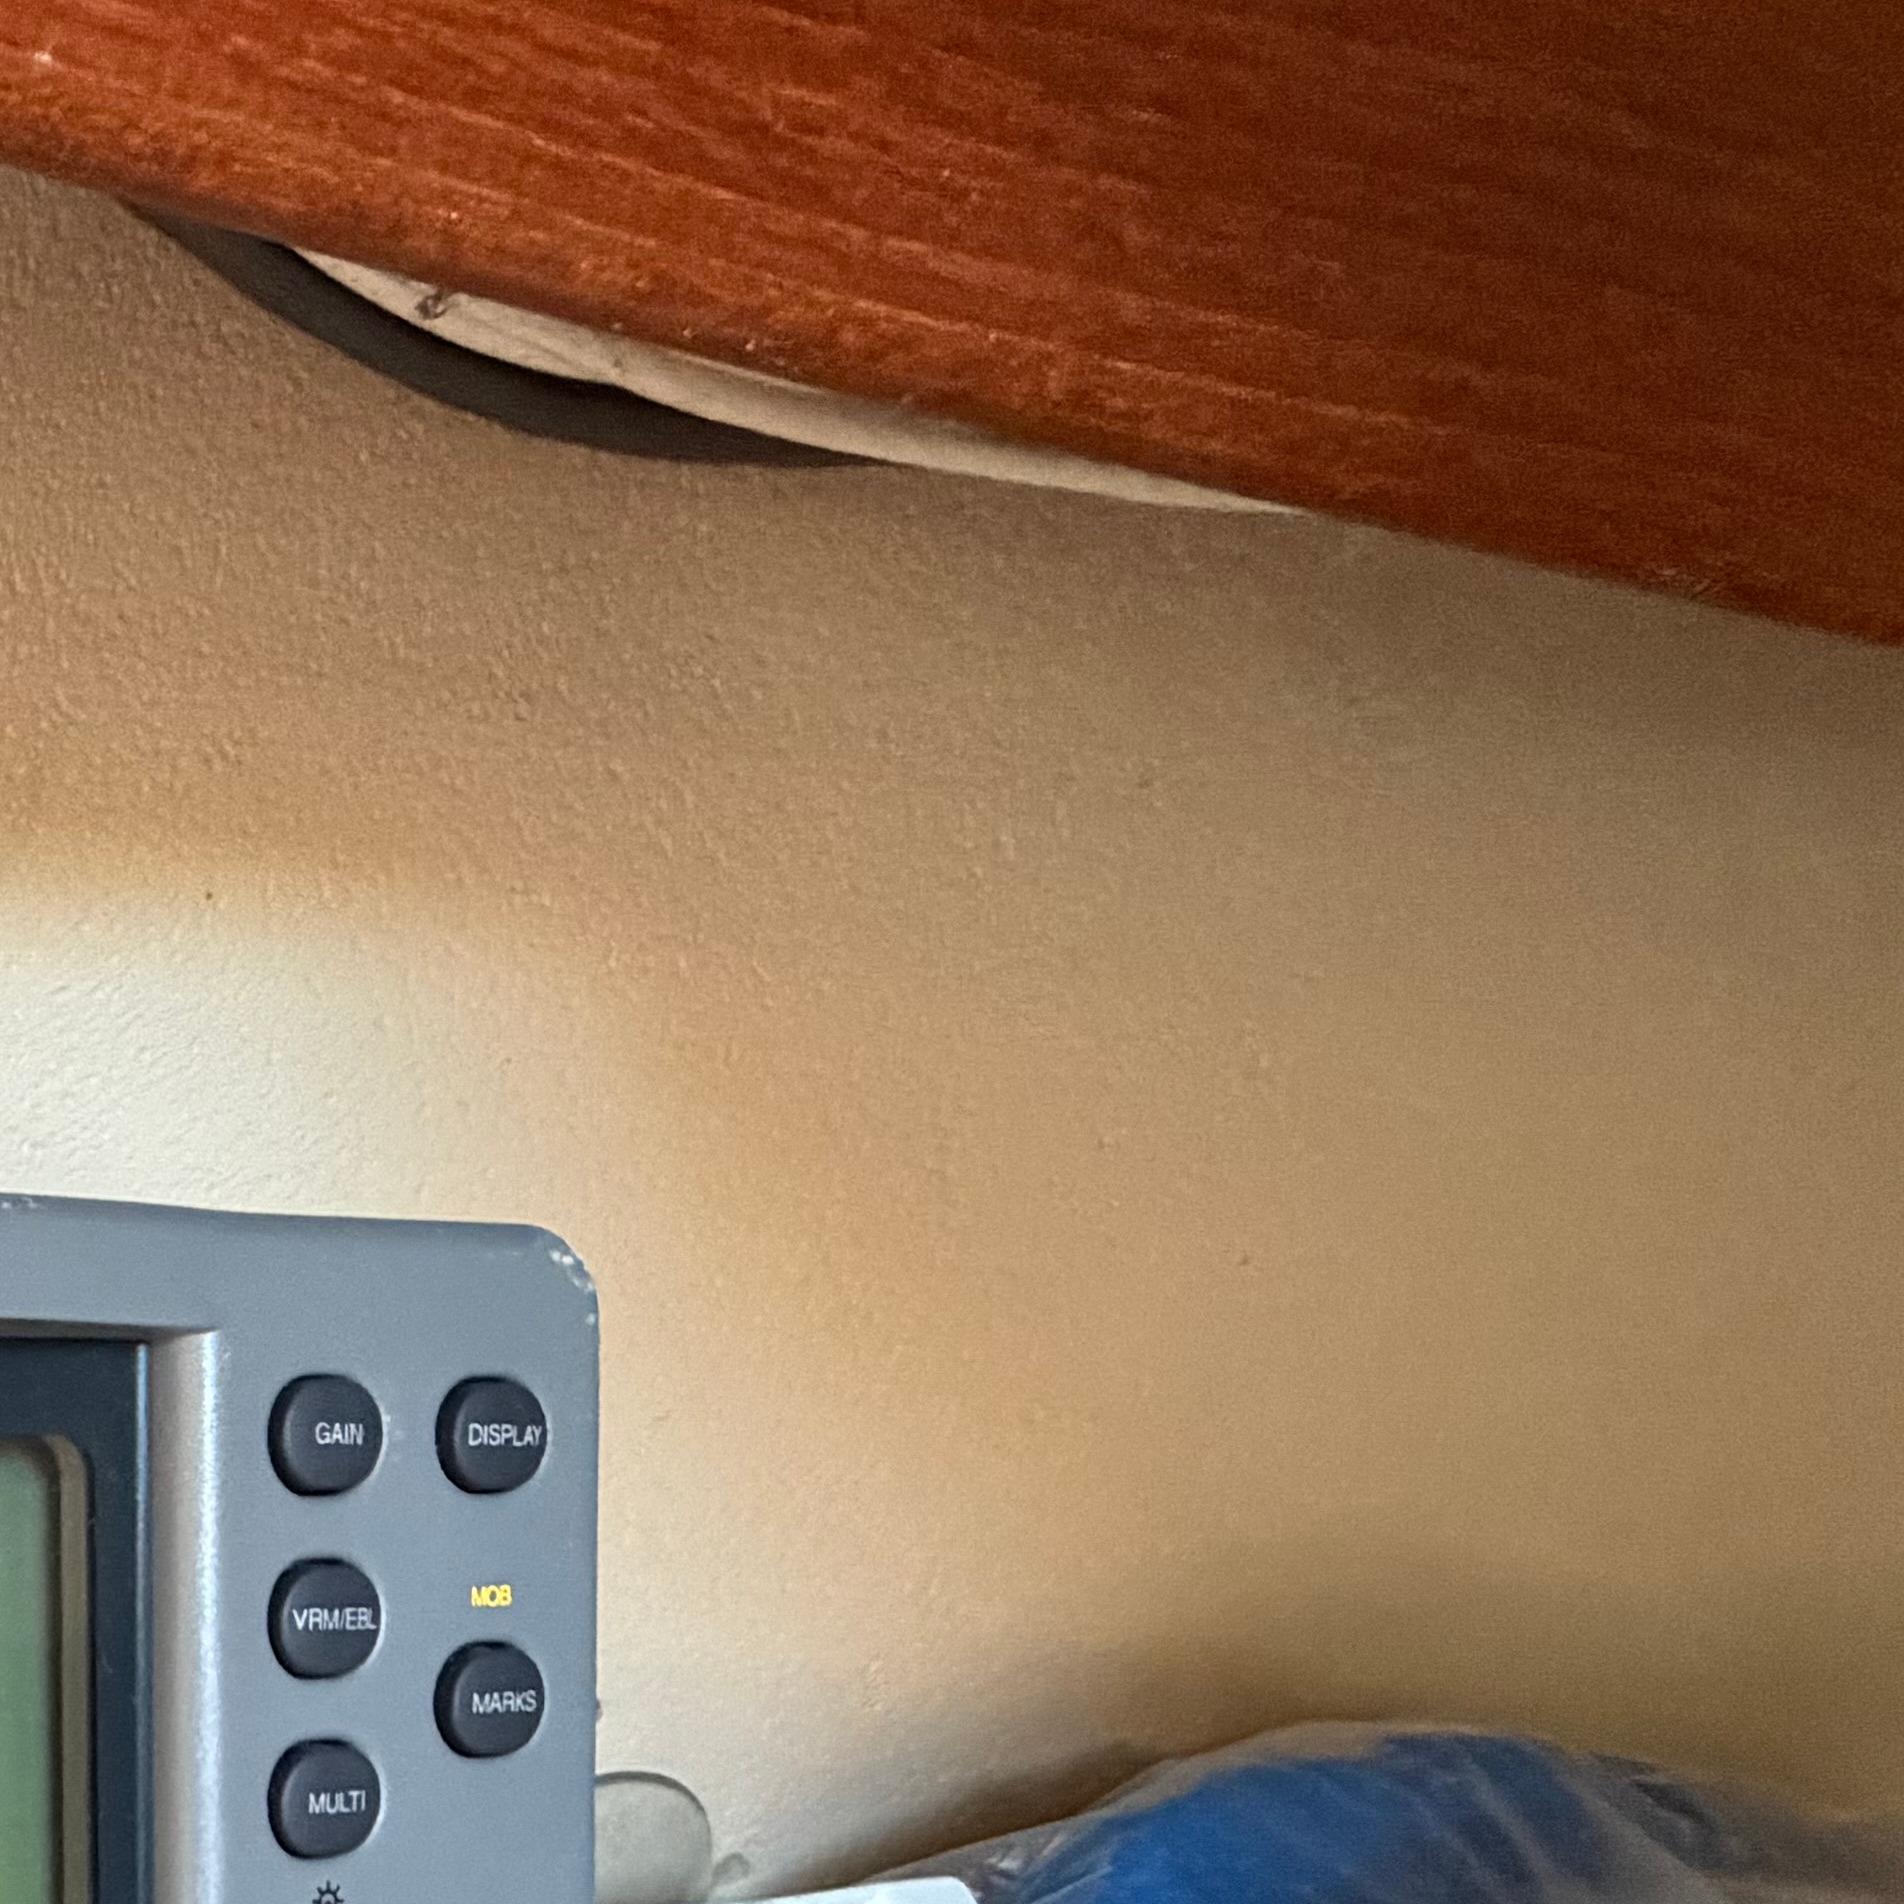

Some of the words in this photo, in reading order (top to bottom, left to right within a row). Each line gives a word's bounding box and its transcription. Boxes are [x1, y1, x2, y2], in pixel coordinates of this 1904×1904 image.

[315, 1422, 364, 1445] GAIN
[468, 1423, 542, 1447] DISPLAY
[471, 1584, 512, 1607] MOB
[292, 1607, 377, 1631] VRM/EBL
[472, 1689, 538, 1714] MARKS
[308, 1790, 367, 1814] MULTI
